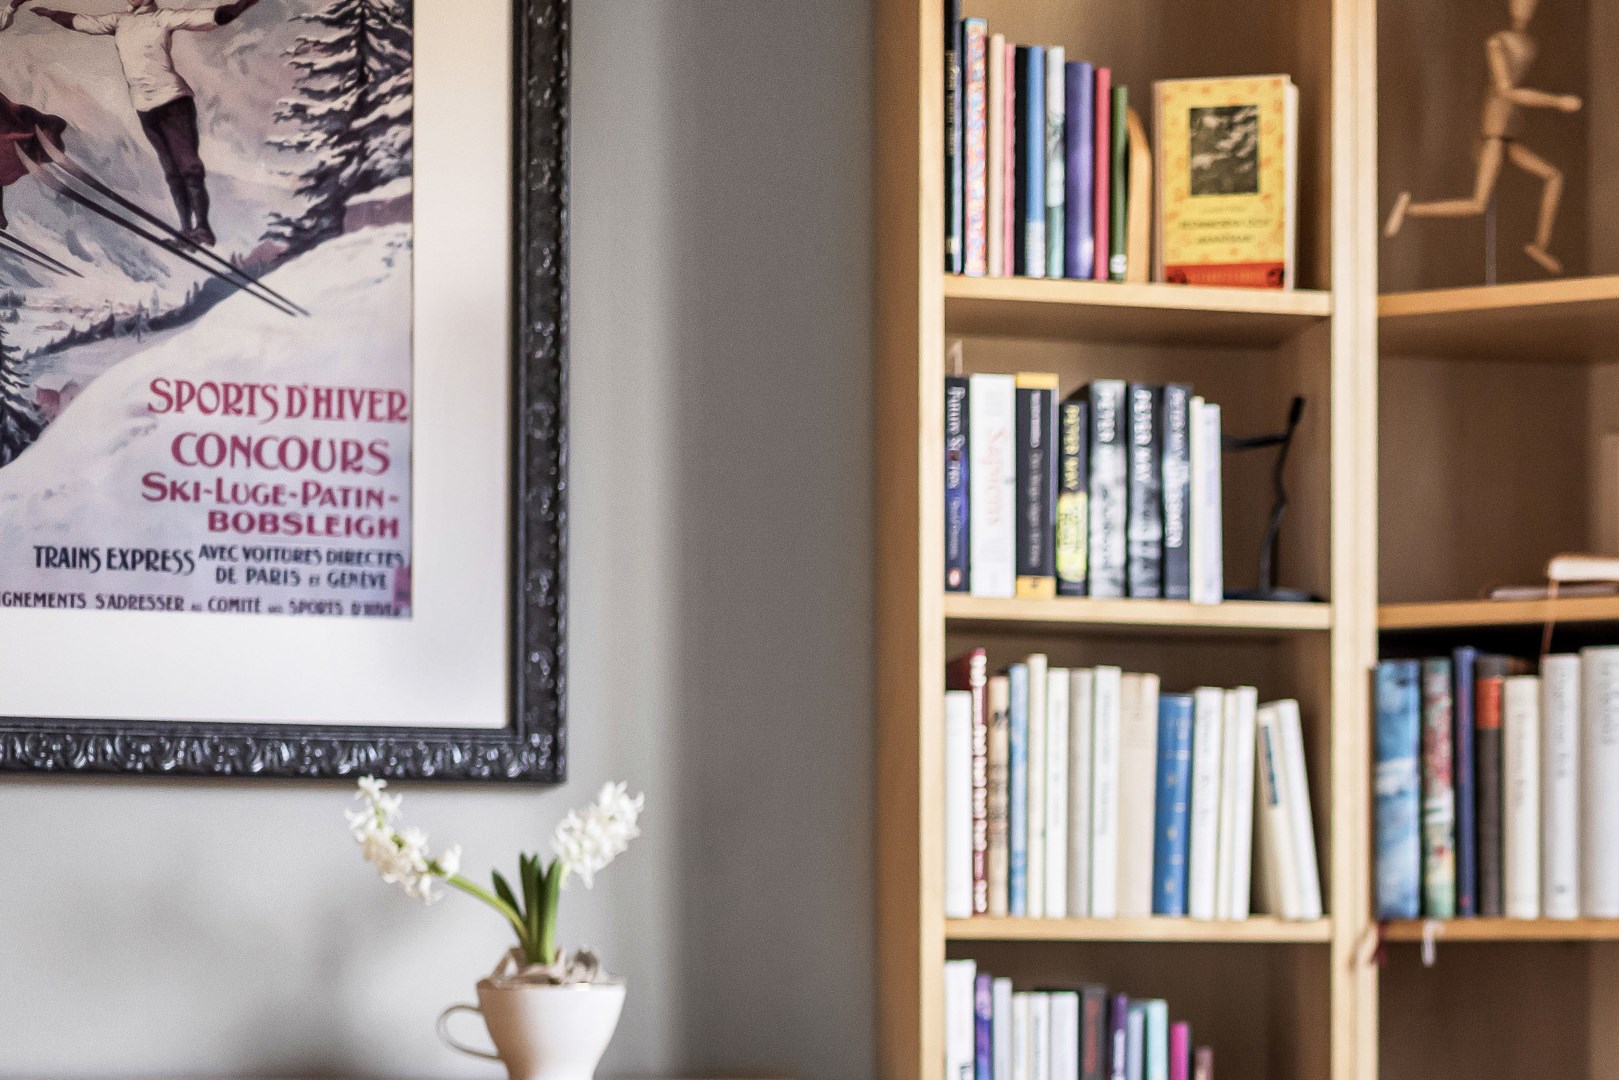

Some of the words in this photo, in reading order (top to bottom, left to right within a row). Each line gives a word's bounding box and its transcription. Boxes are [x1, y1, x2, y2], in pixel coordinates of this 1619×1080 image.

[148, 377, 279, 425] SPORTS
[284, 384, 409, 424] D'HIVER
[1133, 389, 1153, 446] PETER
[170, 431, 391, 476] CONCOURS
[207, 509, 400, 540] BOBSLEIGH
[33, 545, 102, 575] TRAINS
[105, 547, 196, 577] EXPRESS
[199, 543, 239, 563] AVEC
[241, 546, 323, 566] VOITURES
[326, 548, 405, 568] DIRECTES
[215, 566, 236, 585] DE
[246, 566, 300, 587] PARIS
[95, 592, 185, 612] S'ADRESSER
